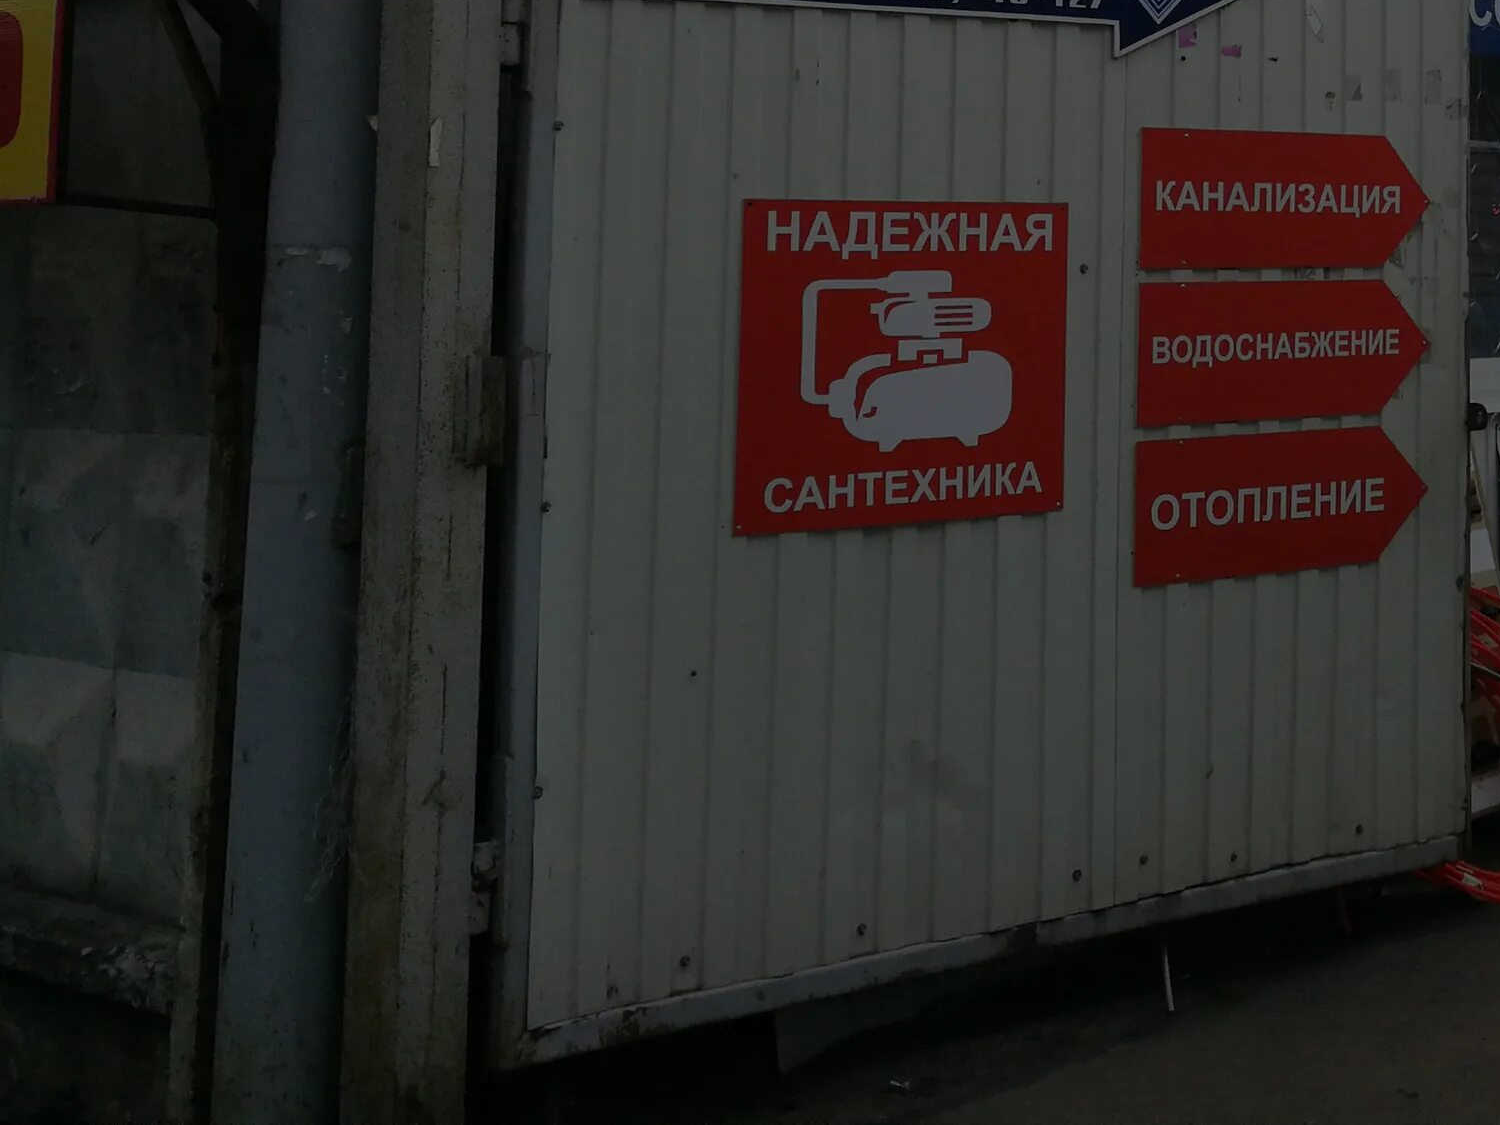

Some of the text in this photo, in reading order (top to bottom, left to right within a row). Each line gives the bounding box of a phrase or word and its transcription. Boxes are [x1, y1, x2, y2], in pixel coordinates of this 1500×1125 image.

[1156, 181, 1400, 218] КАНАЛИЗАЦИЯ
[766, 211, 1054, 260] НАДЕЖНАЯ
[1151, 328, 1400, 367] ВОДОСНАБЖЕНИЕ
[763, 461, 1042, 514] САНТЕХНИКА
[1150, 478, 1385, 531] ОТОПЛЕНИЕ
